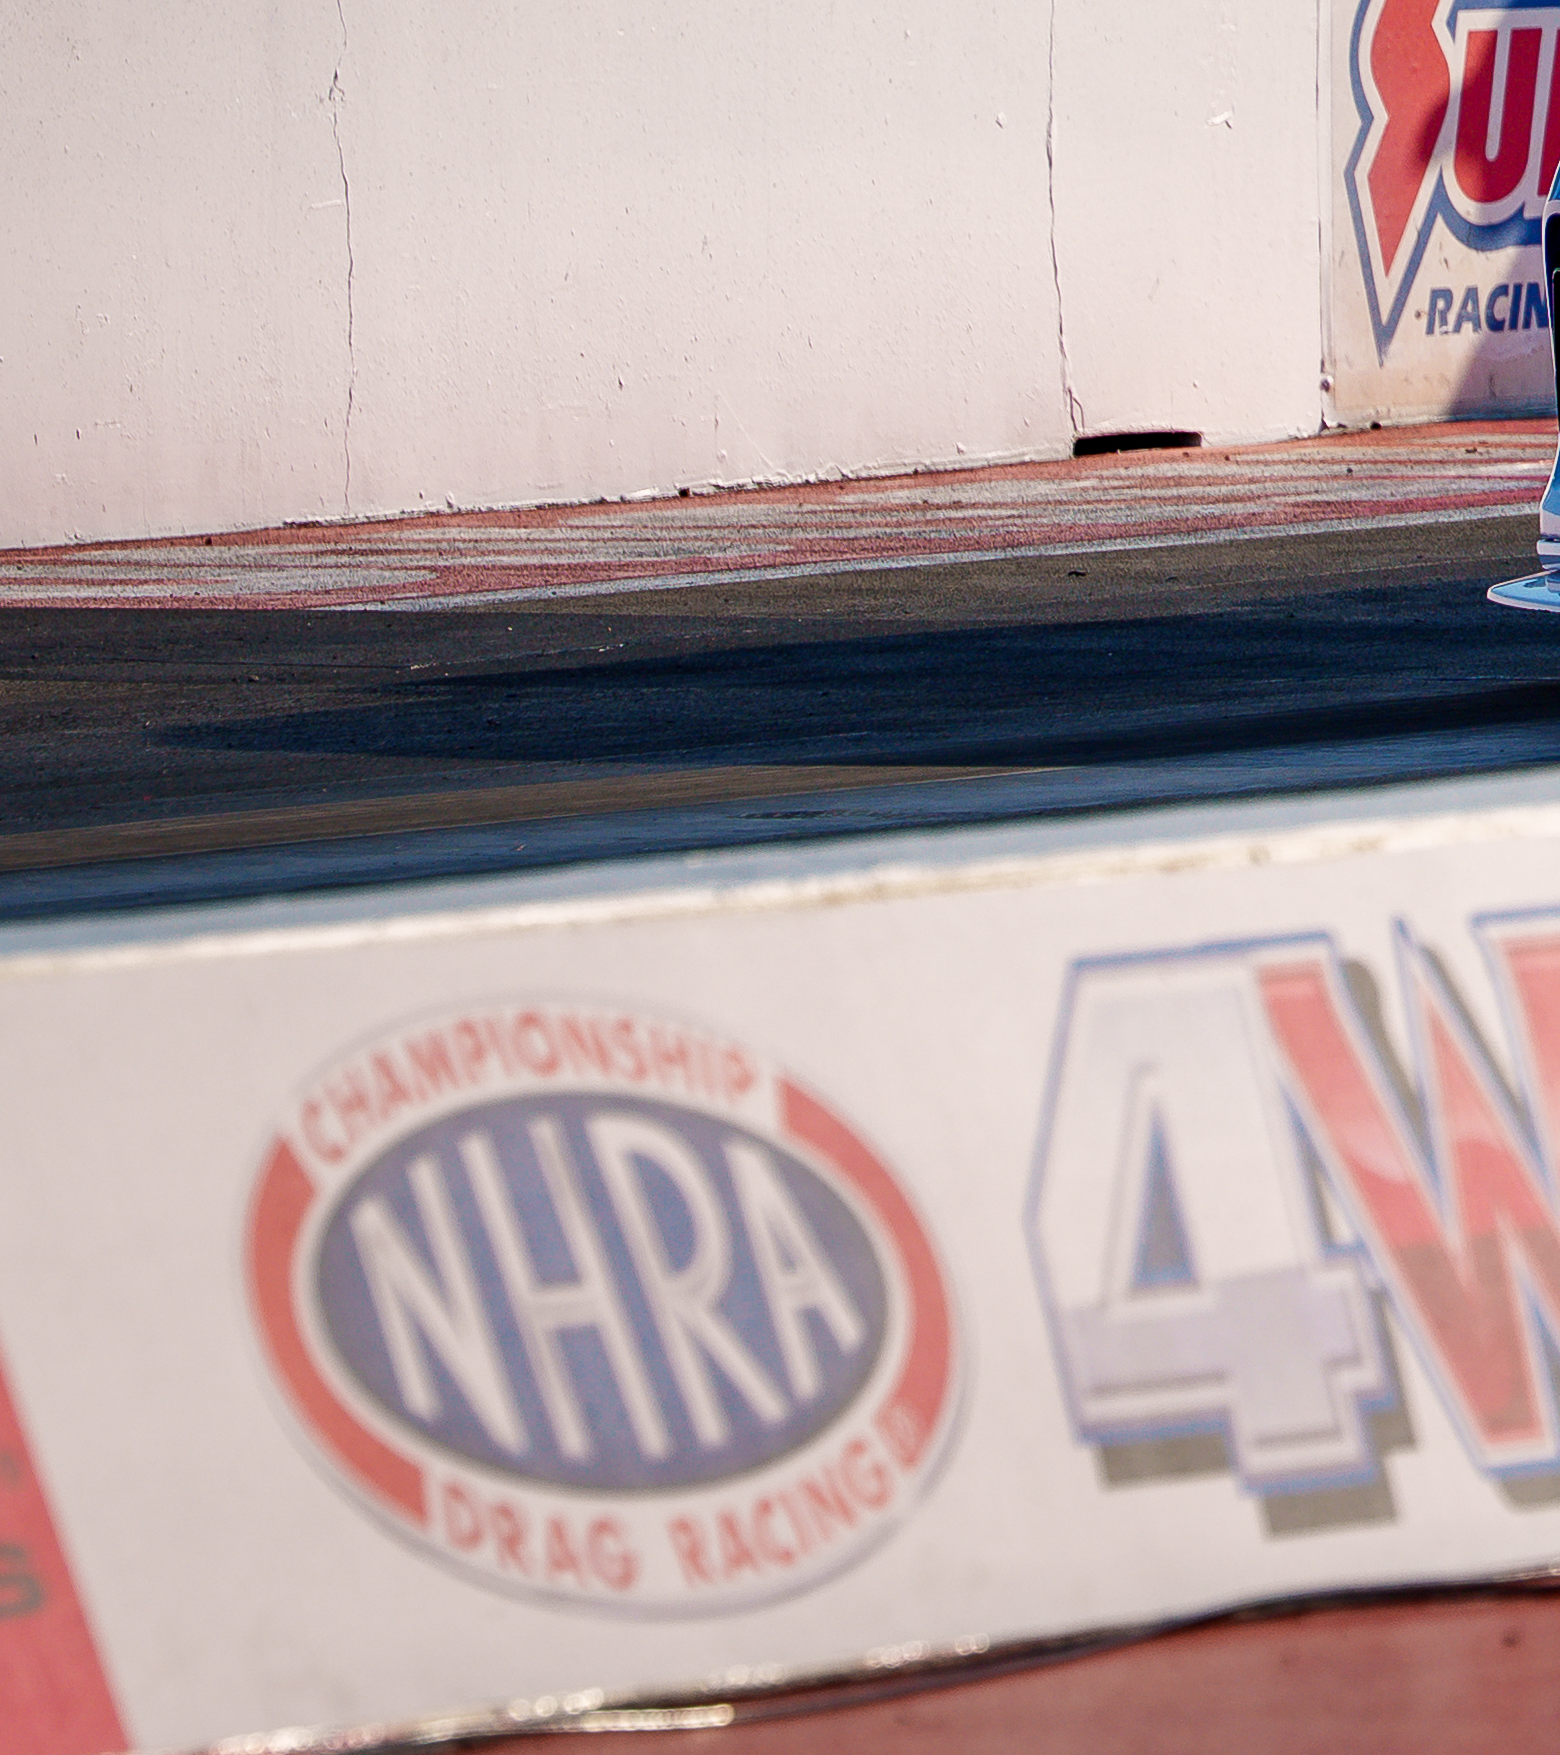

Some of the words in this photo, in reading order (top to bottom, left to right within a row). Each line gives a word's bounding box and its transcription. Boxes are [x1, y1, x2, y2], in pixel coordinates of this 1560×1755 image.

[1424, 280, 1549, 336] RACIN
[300, 1008, 759, 1166] CHAMPIONSHIP
[347, 1110, 868, 1459] NHRA
[436, 1479, 641, 1594] DRAG
[670, 1434, 894, 1592] RACING
